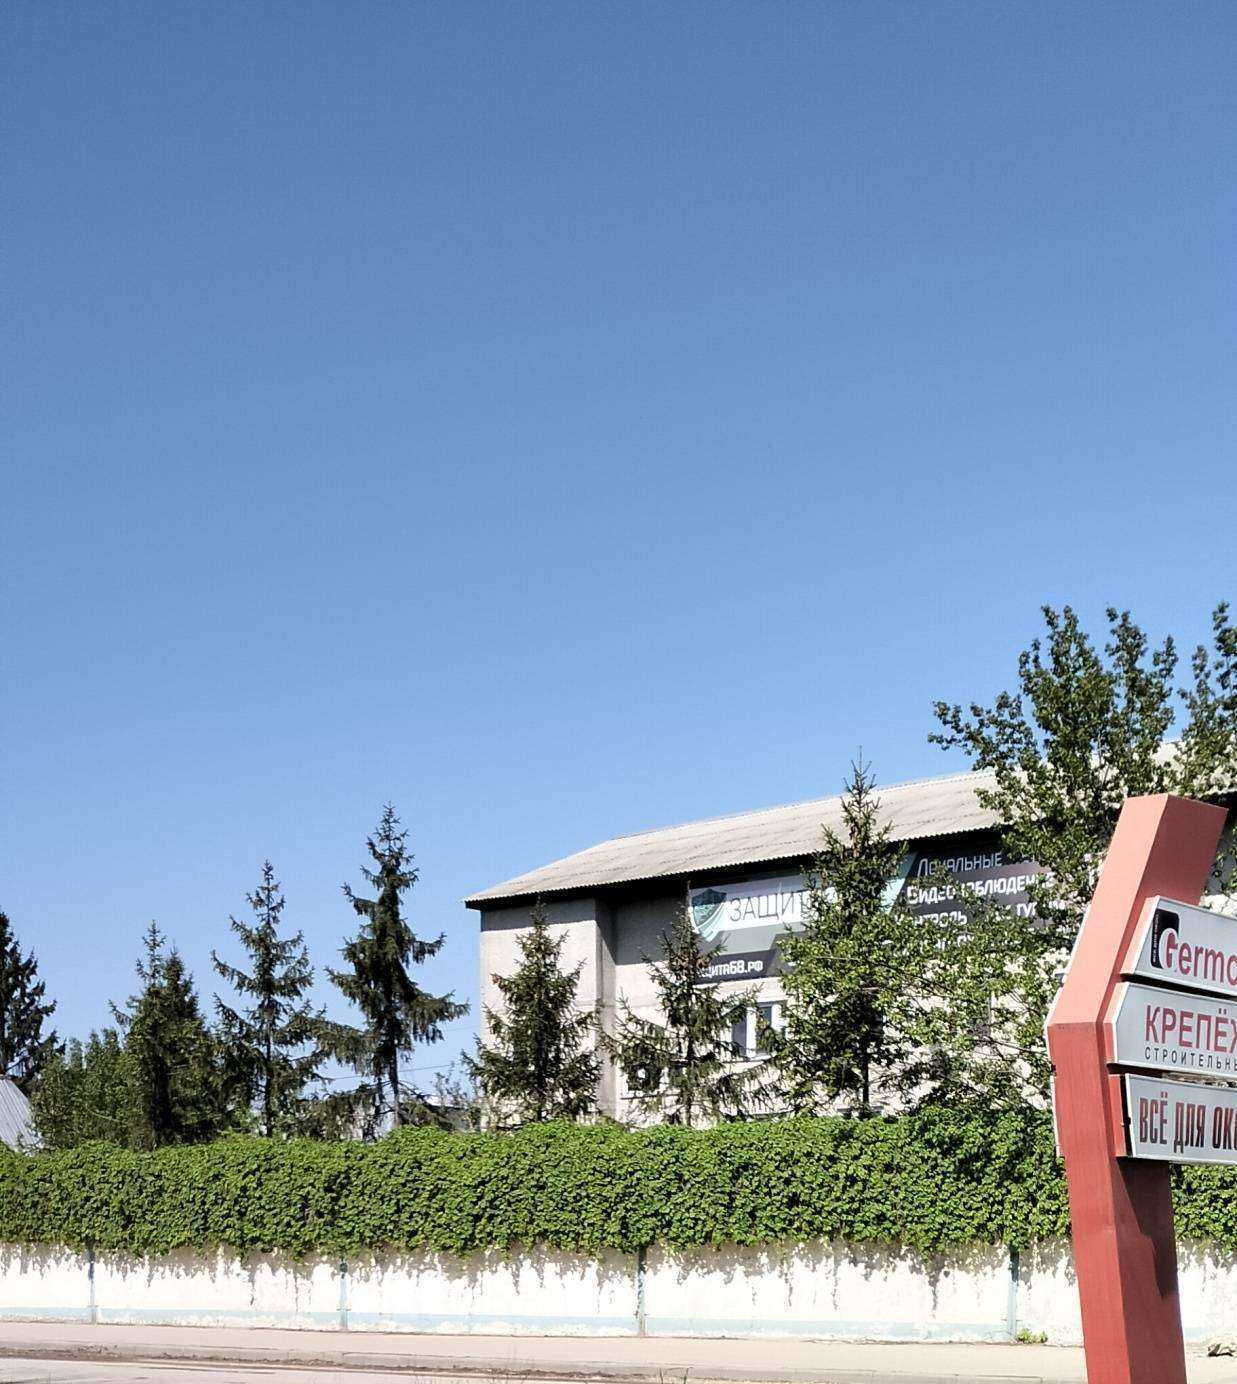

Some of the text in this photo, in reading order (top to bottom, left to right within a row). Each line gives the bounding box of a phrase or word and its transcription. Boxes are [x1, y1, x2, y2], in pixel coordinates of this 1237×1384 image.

[730, 888, 812, 921] ЗАЩИТ
[1140, 1091, 1168, 1144] ВСЁ
[1174, 1102, 1206, 1154] ДЛЯ
